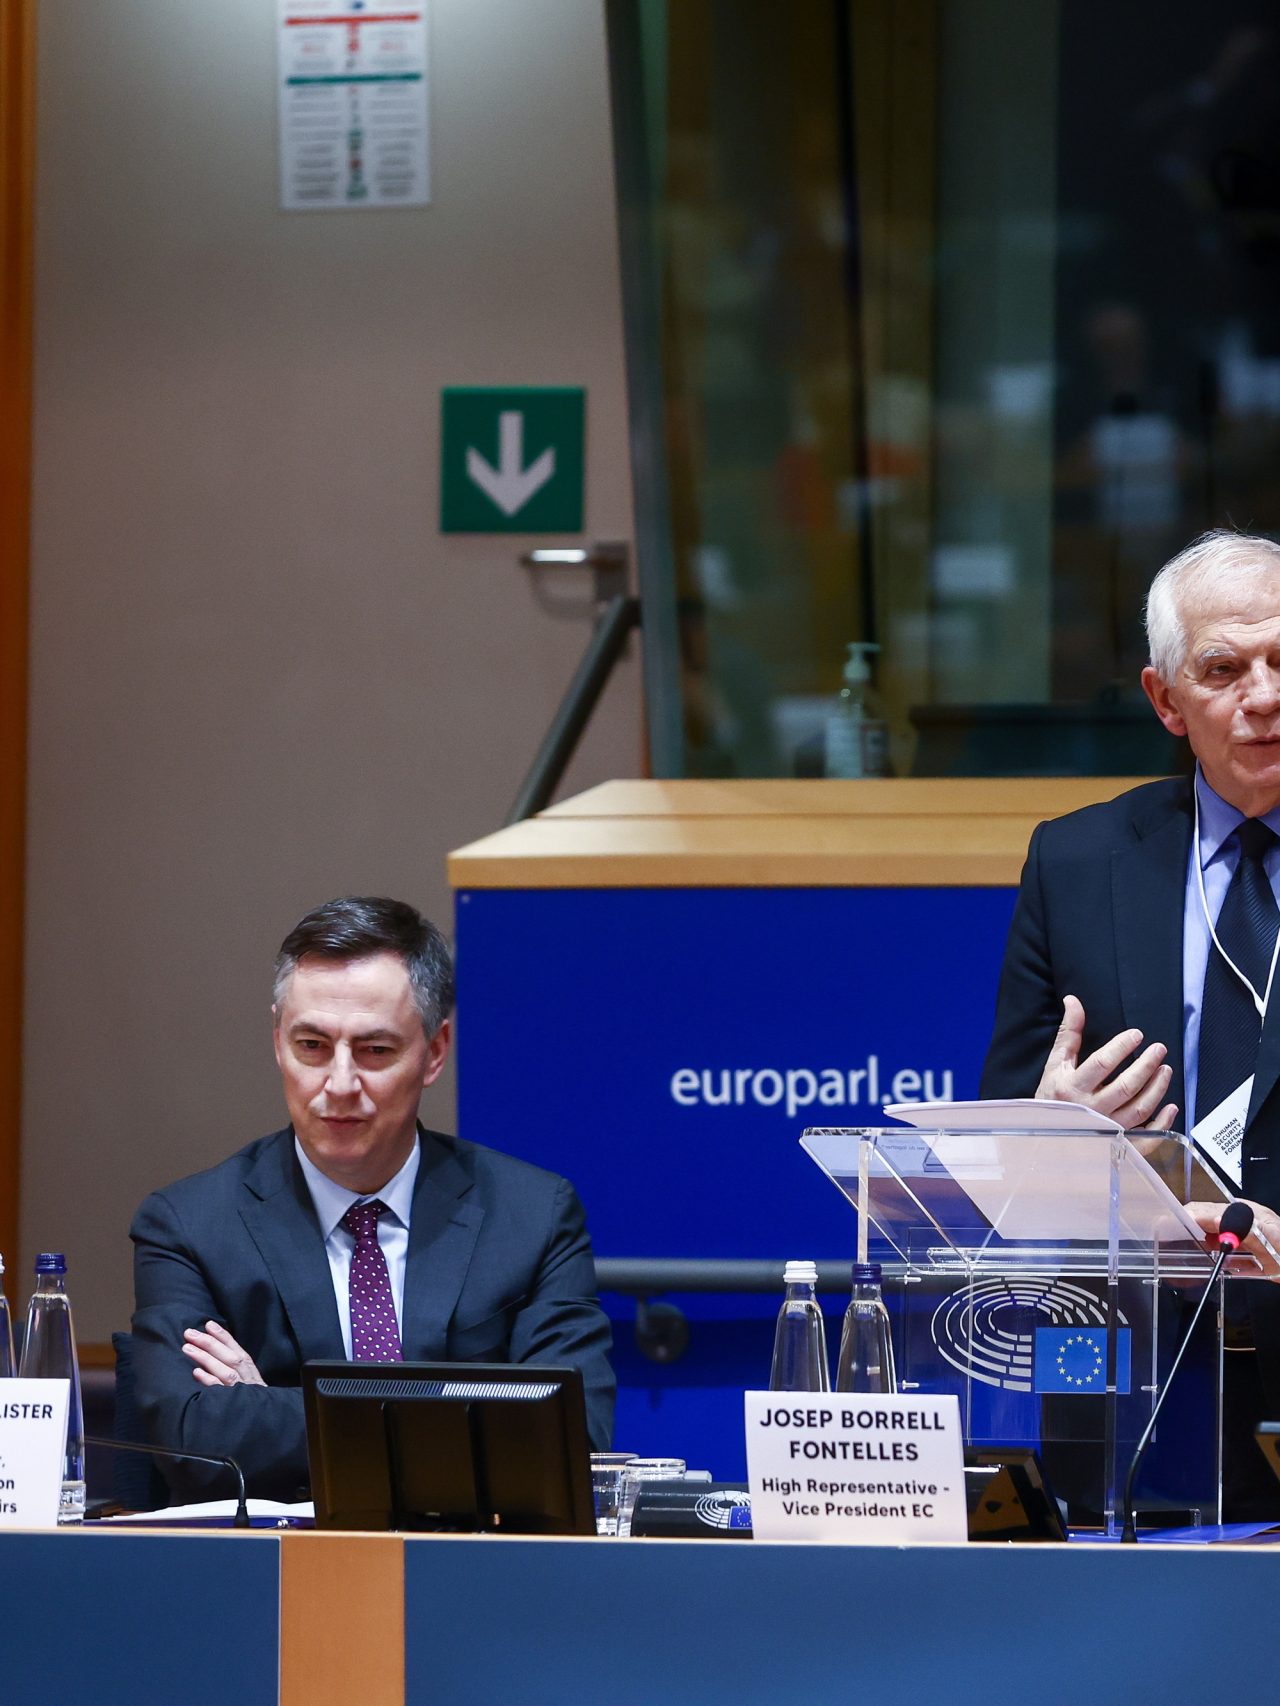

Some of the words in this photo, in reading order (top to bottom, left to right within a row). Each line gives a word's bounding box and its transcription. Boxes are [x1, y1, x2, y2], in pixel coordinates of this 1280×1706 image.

[670, 1055, 954, 1118] europarl.eu
[1212, 1117, 1238, 1142] SCHUMAN
[1216, 1122, 1242, 1147] SECURITY
[0, 1403, 53, 1419] ISTER
[759, 1408, 833, 1428] JOSEP
[841, 1410, 946, 1431] BORRELL
[789, 1440, 919, 1462] FONTELLES
[761, 1477, 802, 1496] High
[806, 1477, 938, 1497] Representative
[782, 1500, 820, 1516] Vice
[824, 1501, 907, 1518] President
[911, 1503, 935, 1518] EC
